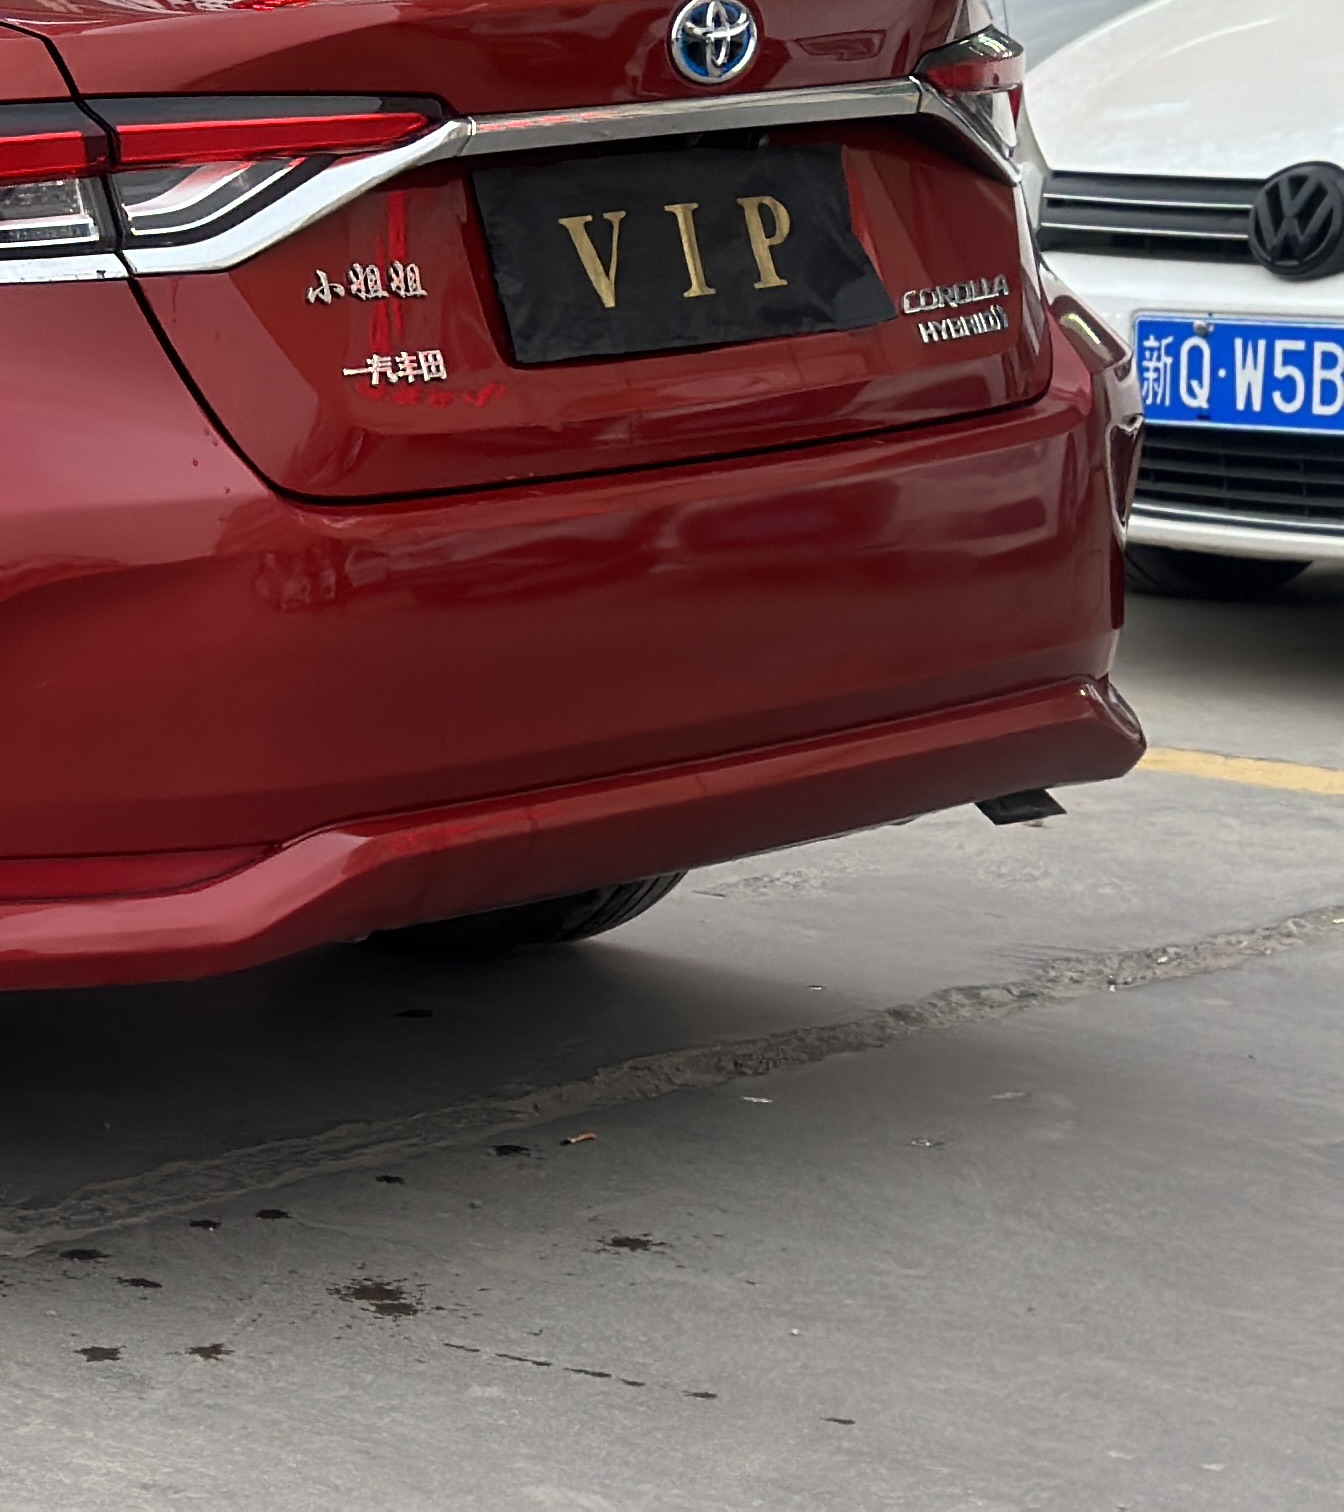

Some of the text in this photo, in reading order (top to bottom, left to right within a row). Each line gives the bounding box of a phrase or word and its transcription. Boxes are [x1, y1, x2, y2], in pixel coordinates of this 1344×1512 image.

[558, 195, 791, 308] VIP
[305, 260, 428, 305] 小姐姐
[902, 274, 1010, 314] COROLLA
[918, 304, 1009, 343] HYBRID
[342, 349, 447, 386] 一汽丰田
